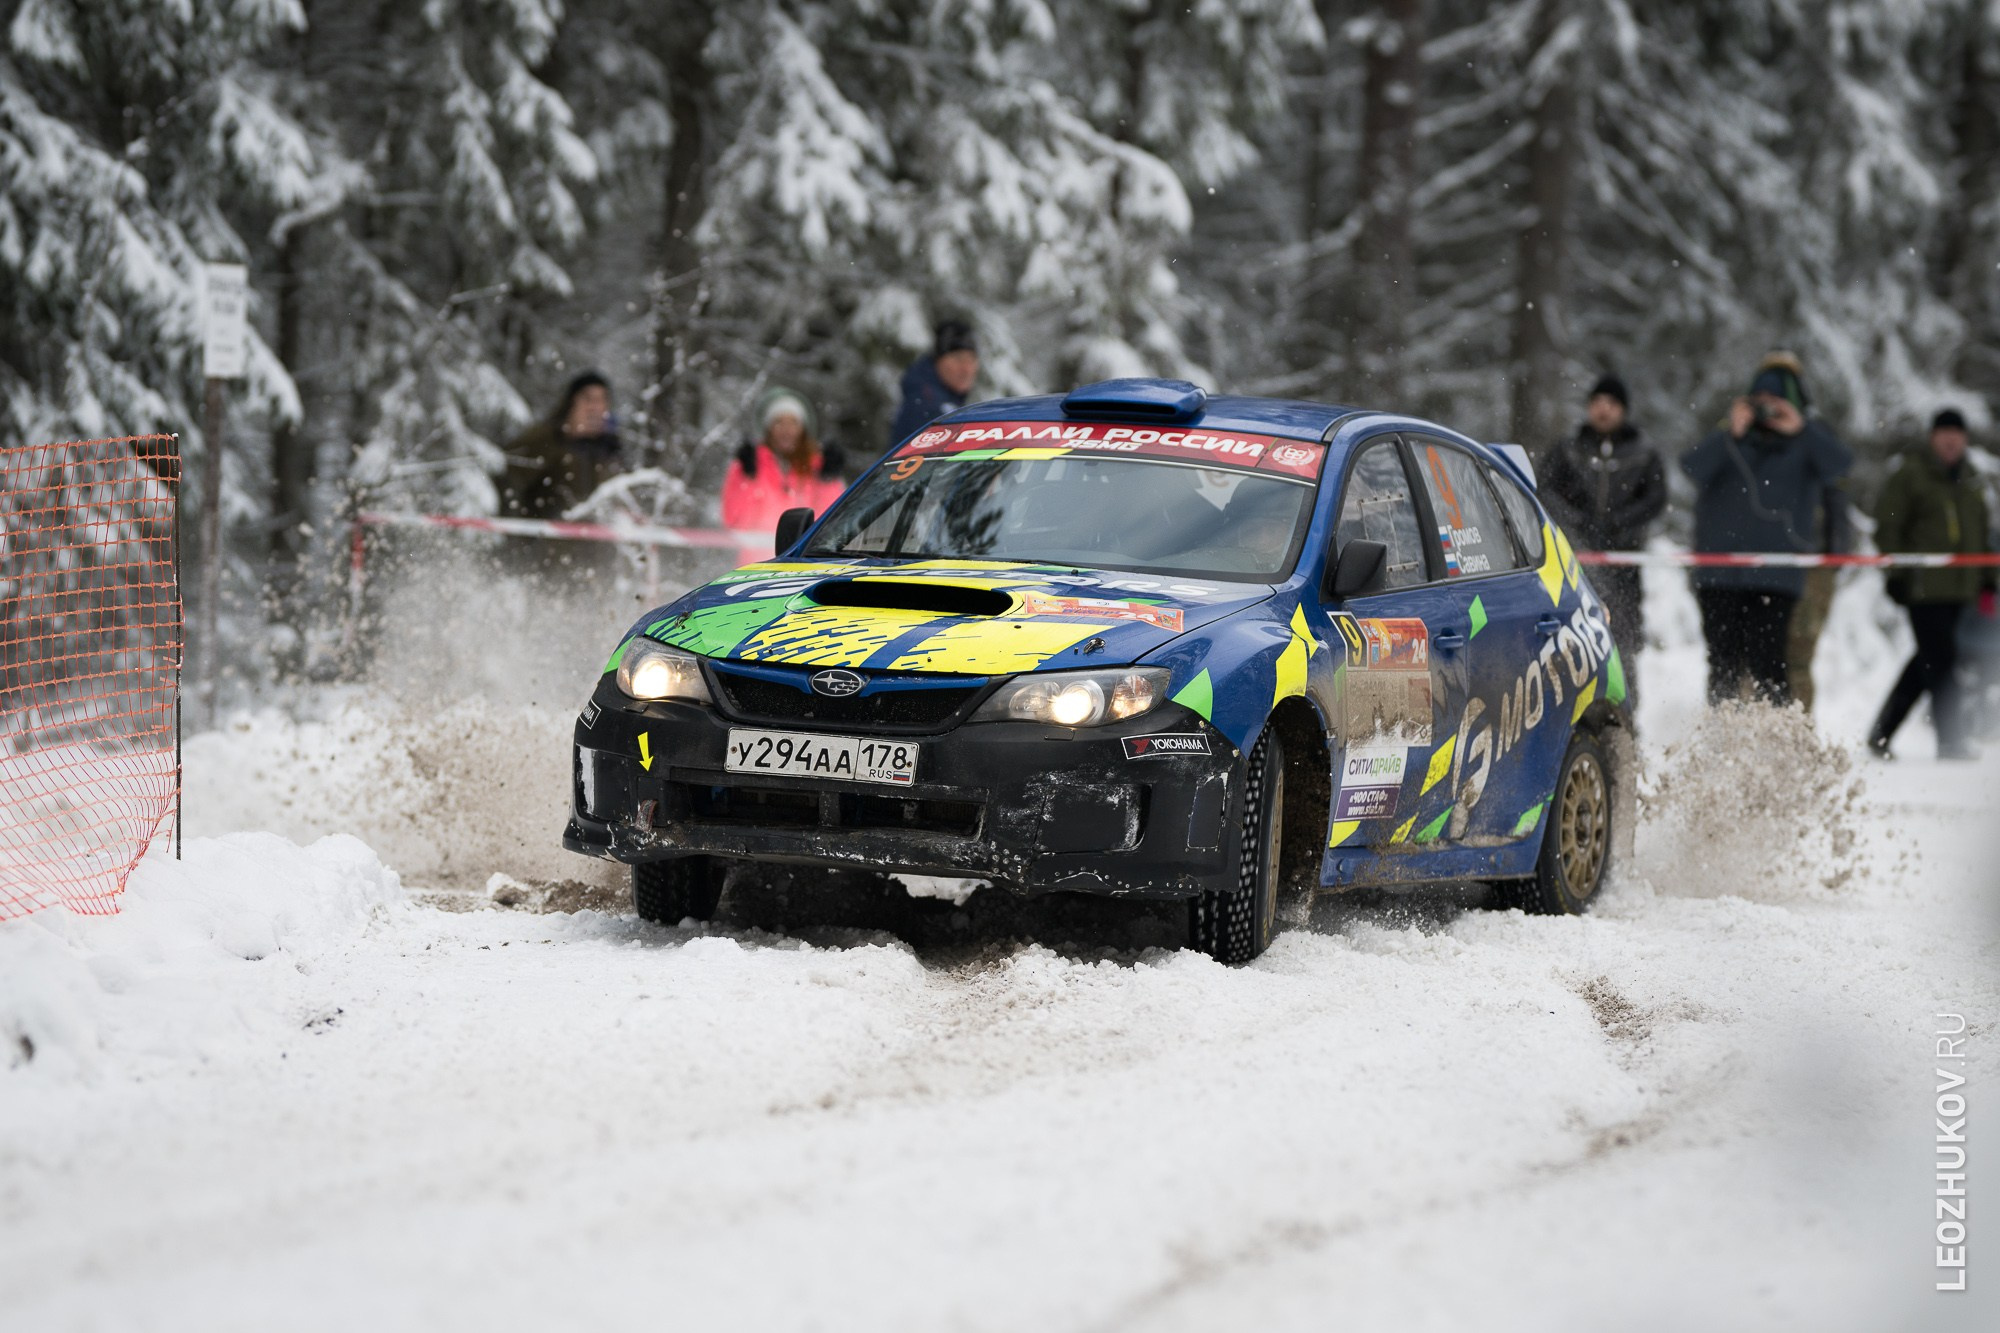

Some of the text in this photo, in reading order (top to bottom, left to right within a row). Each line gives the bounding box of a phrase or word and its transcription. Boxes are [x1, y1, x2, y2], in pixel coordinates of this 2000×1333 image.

[955, 426, 1264, 457] РАЛЛИ РОССИИ
[889, 455, 924, 481] 9
[1426, 443, 1463, 530] 9
[1447, 524, 1482, 553] Громов
[1456, 551, 1491, 574] Савина
[1339, 616, 1362, 665] 9
[1412, 638, 1427, 664] 24
[1496, 591, 1612, 763] MOTORS
[861, 743, 907, 770] 178
[1151, 739, 1204, 750] YOKOHAMA
[868, 768, 892, 780] RUS
[1348, 754, 1402, 776] СИТИДРАЙВ
